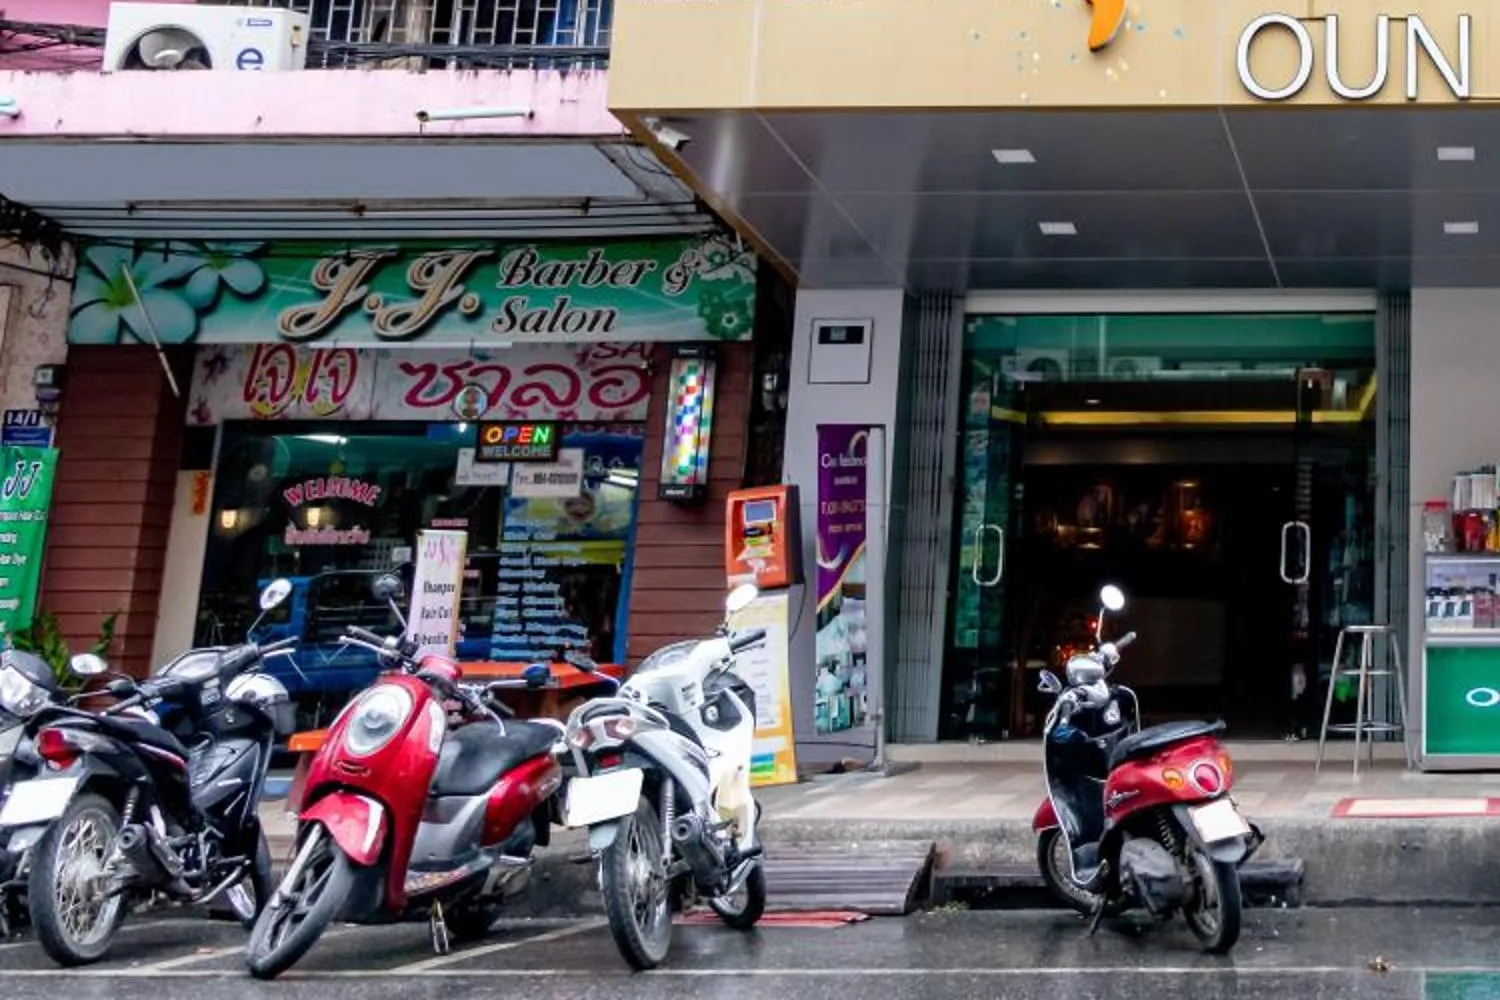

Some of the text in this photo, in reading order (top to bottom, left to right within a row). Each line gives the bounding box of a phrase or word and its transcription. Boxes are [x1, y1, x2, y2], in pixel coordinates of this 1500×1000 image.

[1236, 12, 1472, 100] OUN
[499, 246, 657, 288] Barber
[492, 295, 617, 335] Salon
[7, 411, 38, 426] 14/1
[485, 426, 550, 444] OPEN
[481, 445, 553, 458] WELCOME
[283, 476, 382, 508] WELCOME
